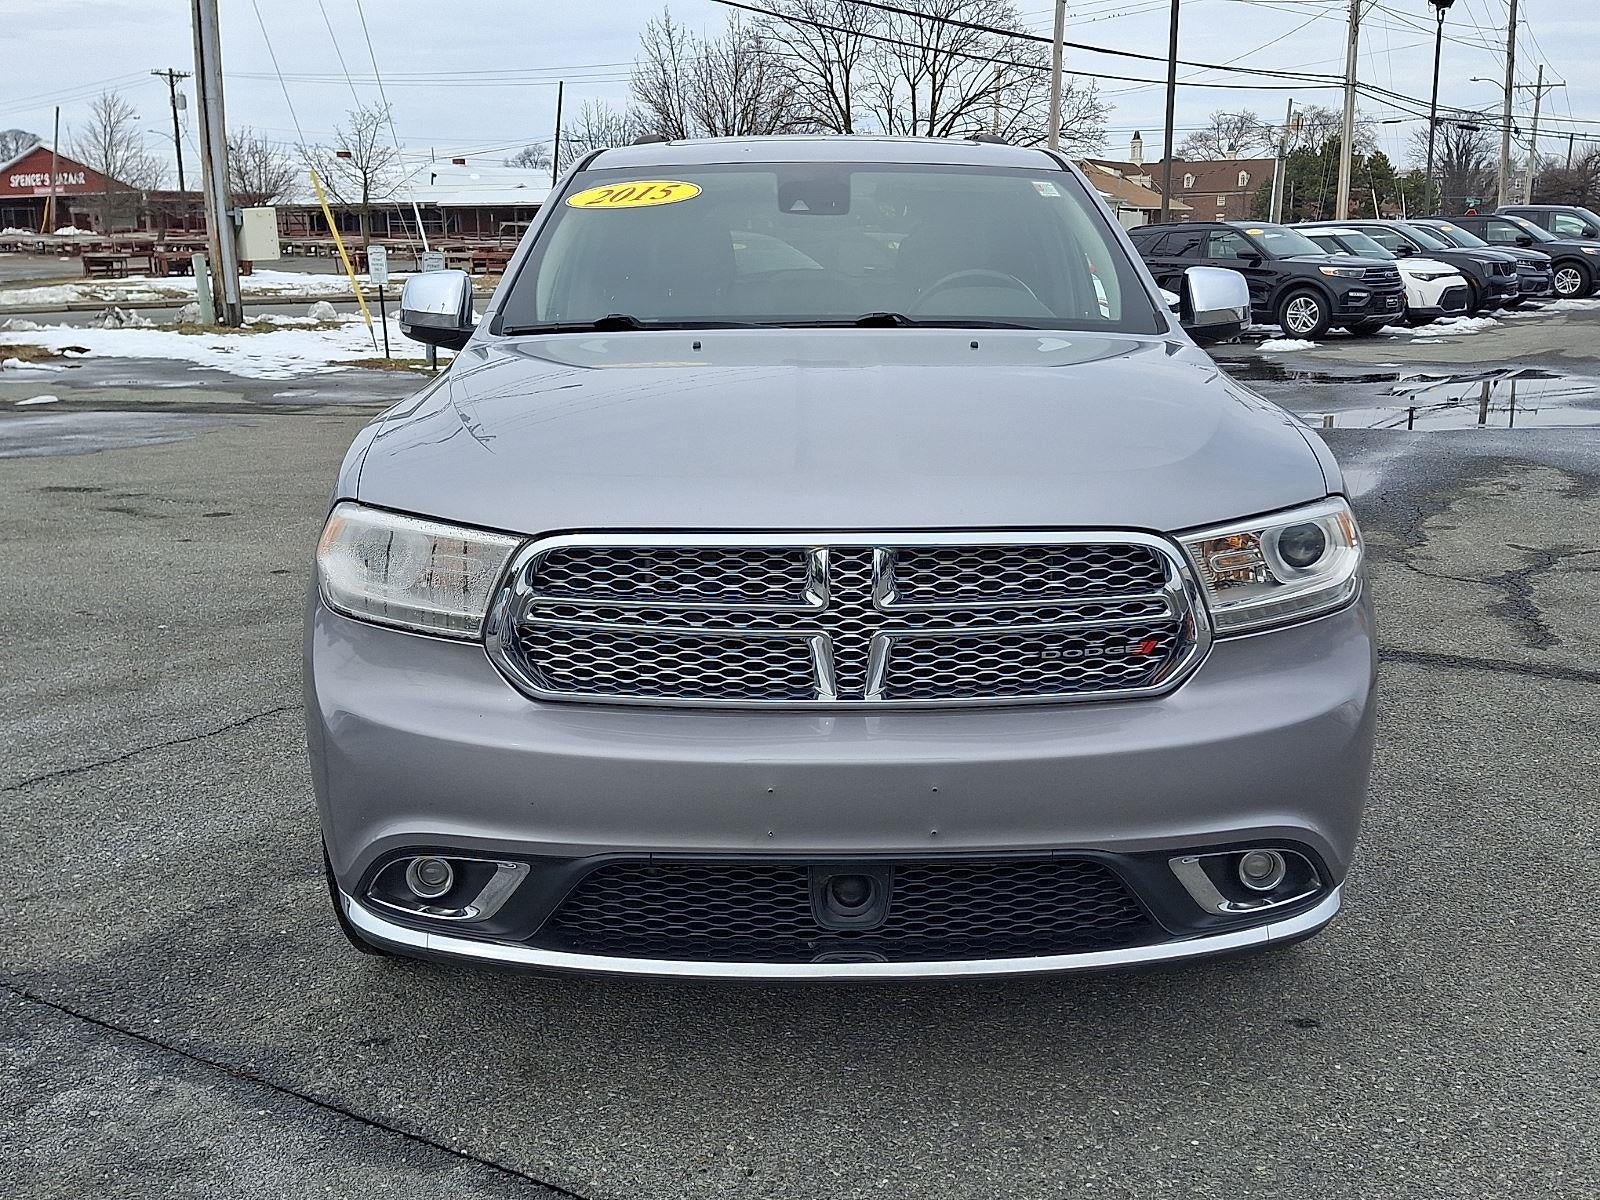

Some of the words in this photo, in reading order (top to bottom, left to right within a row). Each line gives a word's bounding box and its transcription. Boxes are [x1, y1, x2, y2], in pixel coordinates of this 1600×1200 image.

[9, 173, 50, 187] SPENCE'S
[584, 184, 681, 206] 2015
[1041, 644, 1142, 659] DODGE
